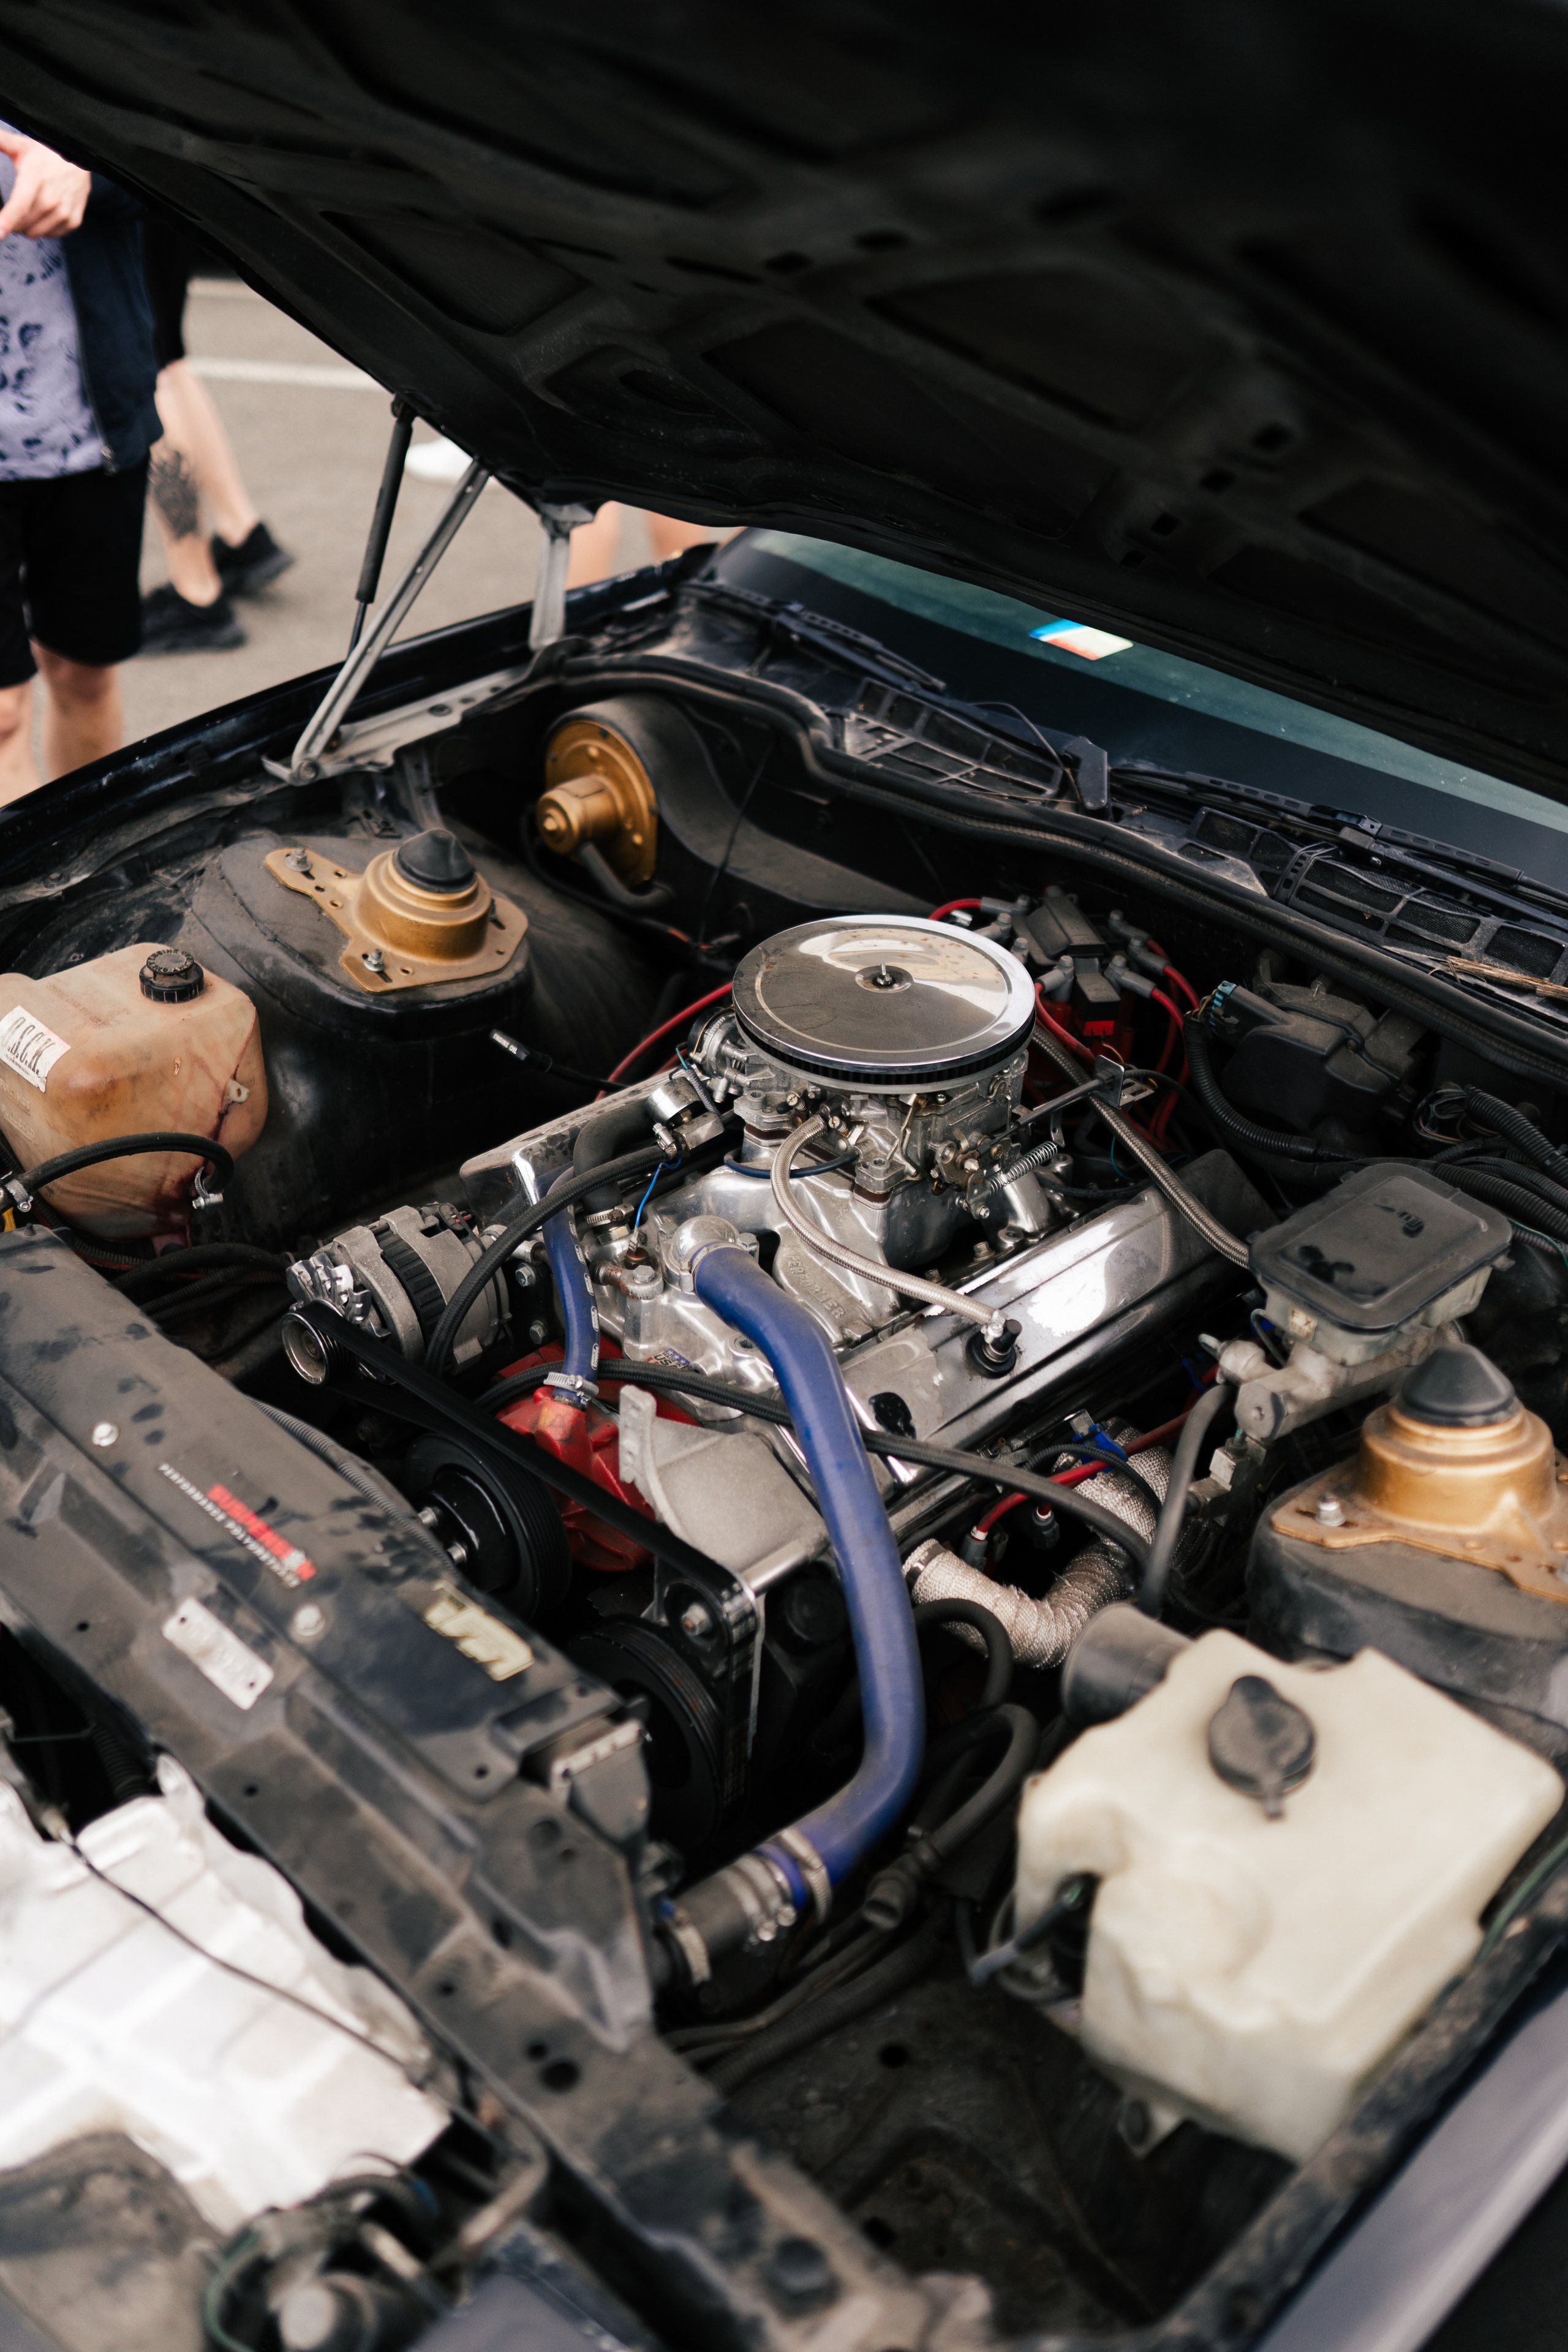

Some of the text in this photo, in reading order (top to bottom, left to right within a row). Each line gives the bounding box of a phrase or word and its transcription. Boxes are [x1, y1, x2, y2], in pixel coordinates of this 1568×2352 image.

[492, 1033, 518, 1054] ENGINE OIL
[786, 1255, 845, 1319] PERFORMER
[654, 1354, 678, 1366] US
[662, 1352, 677, 1363] MADE
[158, 1462, 301, 1588] PERFORMANCE POLYURETHANE
[206, 1482, 317, 1581] SUSPENSIN
